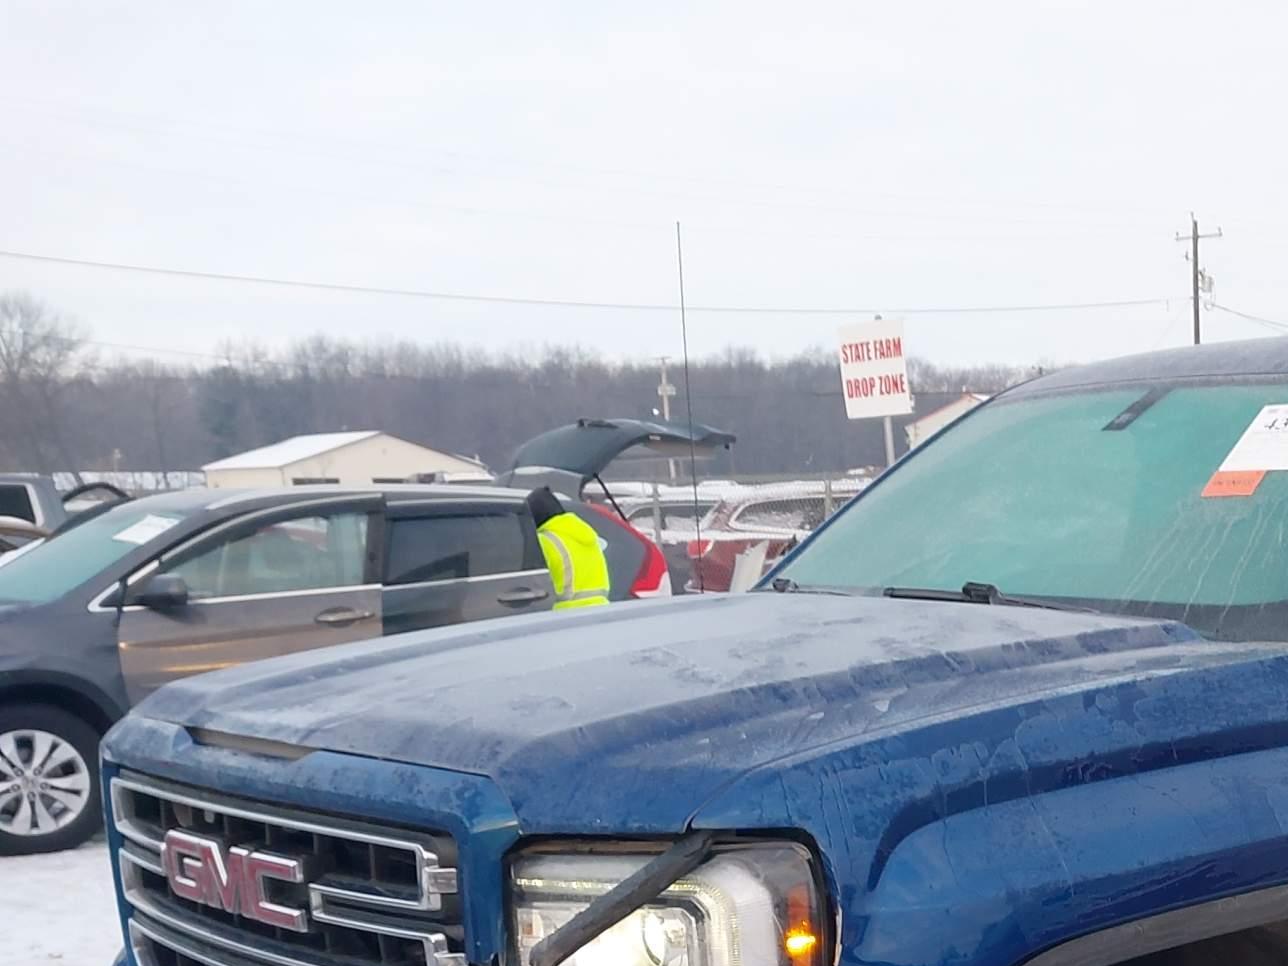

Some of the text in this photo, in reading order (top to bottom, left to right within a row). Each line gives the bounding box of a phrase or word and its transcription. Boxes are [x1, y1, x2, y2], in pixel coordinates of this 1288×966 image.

[842, 336, 903, 364] STATE FARM
[846, 373, 906, 399] DROP ZONE
[163, 829, 308, 933] GMC
